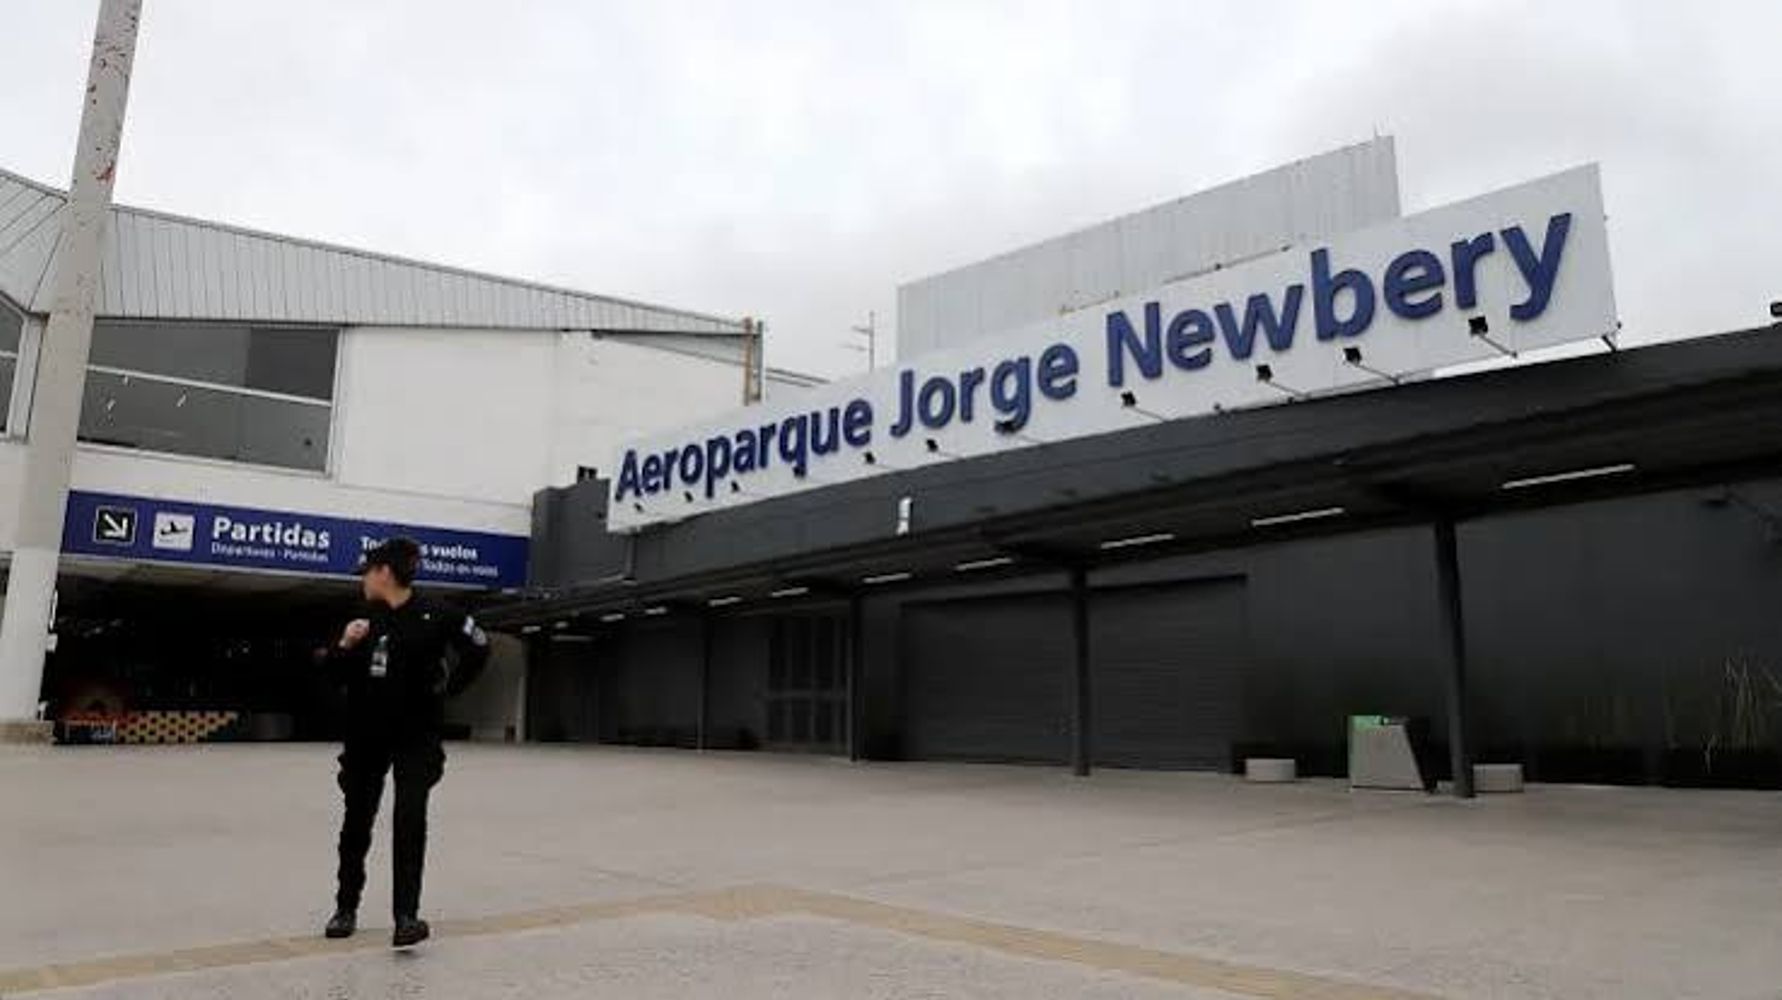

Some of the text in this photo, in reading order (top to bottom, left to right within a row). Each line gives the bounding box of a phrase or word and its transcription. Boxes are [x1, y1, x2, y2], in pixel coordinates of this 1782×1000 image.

[615, 212, 1573, 500] Aeroparque Jorge Newbery
[212, 516, 330, 549] Partidas
[431, 544, 479, 560] vuelos
